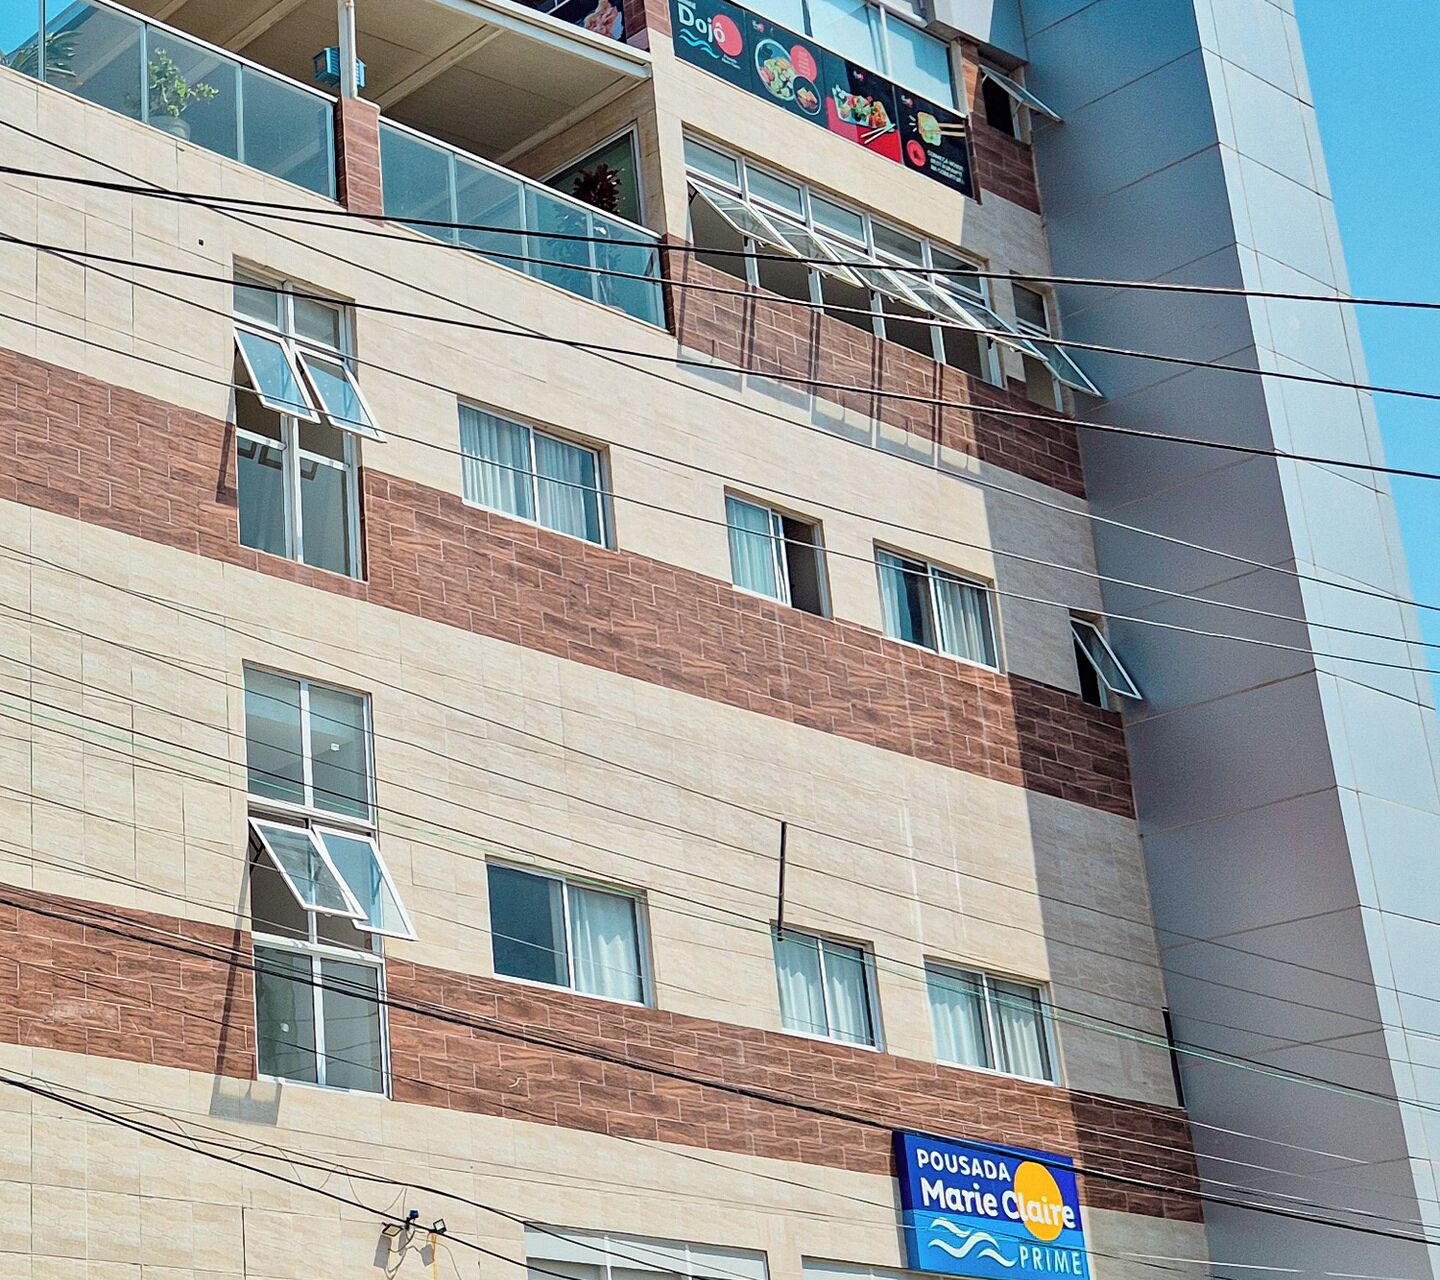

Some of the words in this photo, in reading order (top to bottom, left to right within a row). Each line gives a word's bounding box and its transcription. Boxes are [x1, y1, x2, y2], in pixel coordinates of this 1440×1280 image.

[916, 1148, 1011, 1182] POUSADA
[920, 1177, 999, 1217] Marie
[1002, 1190, 1076, 1229] Claire
[1019, 1246, 1084, 1276] PRIME
